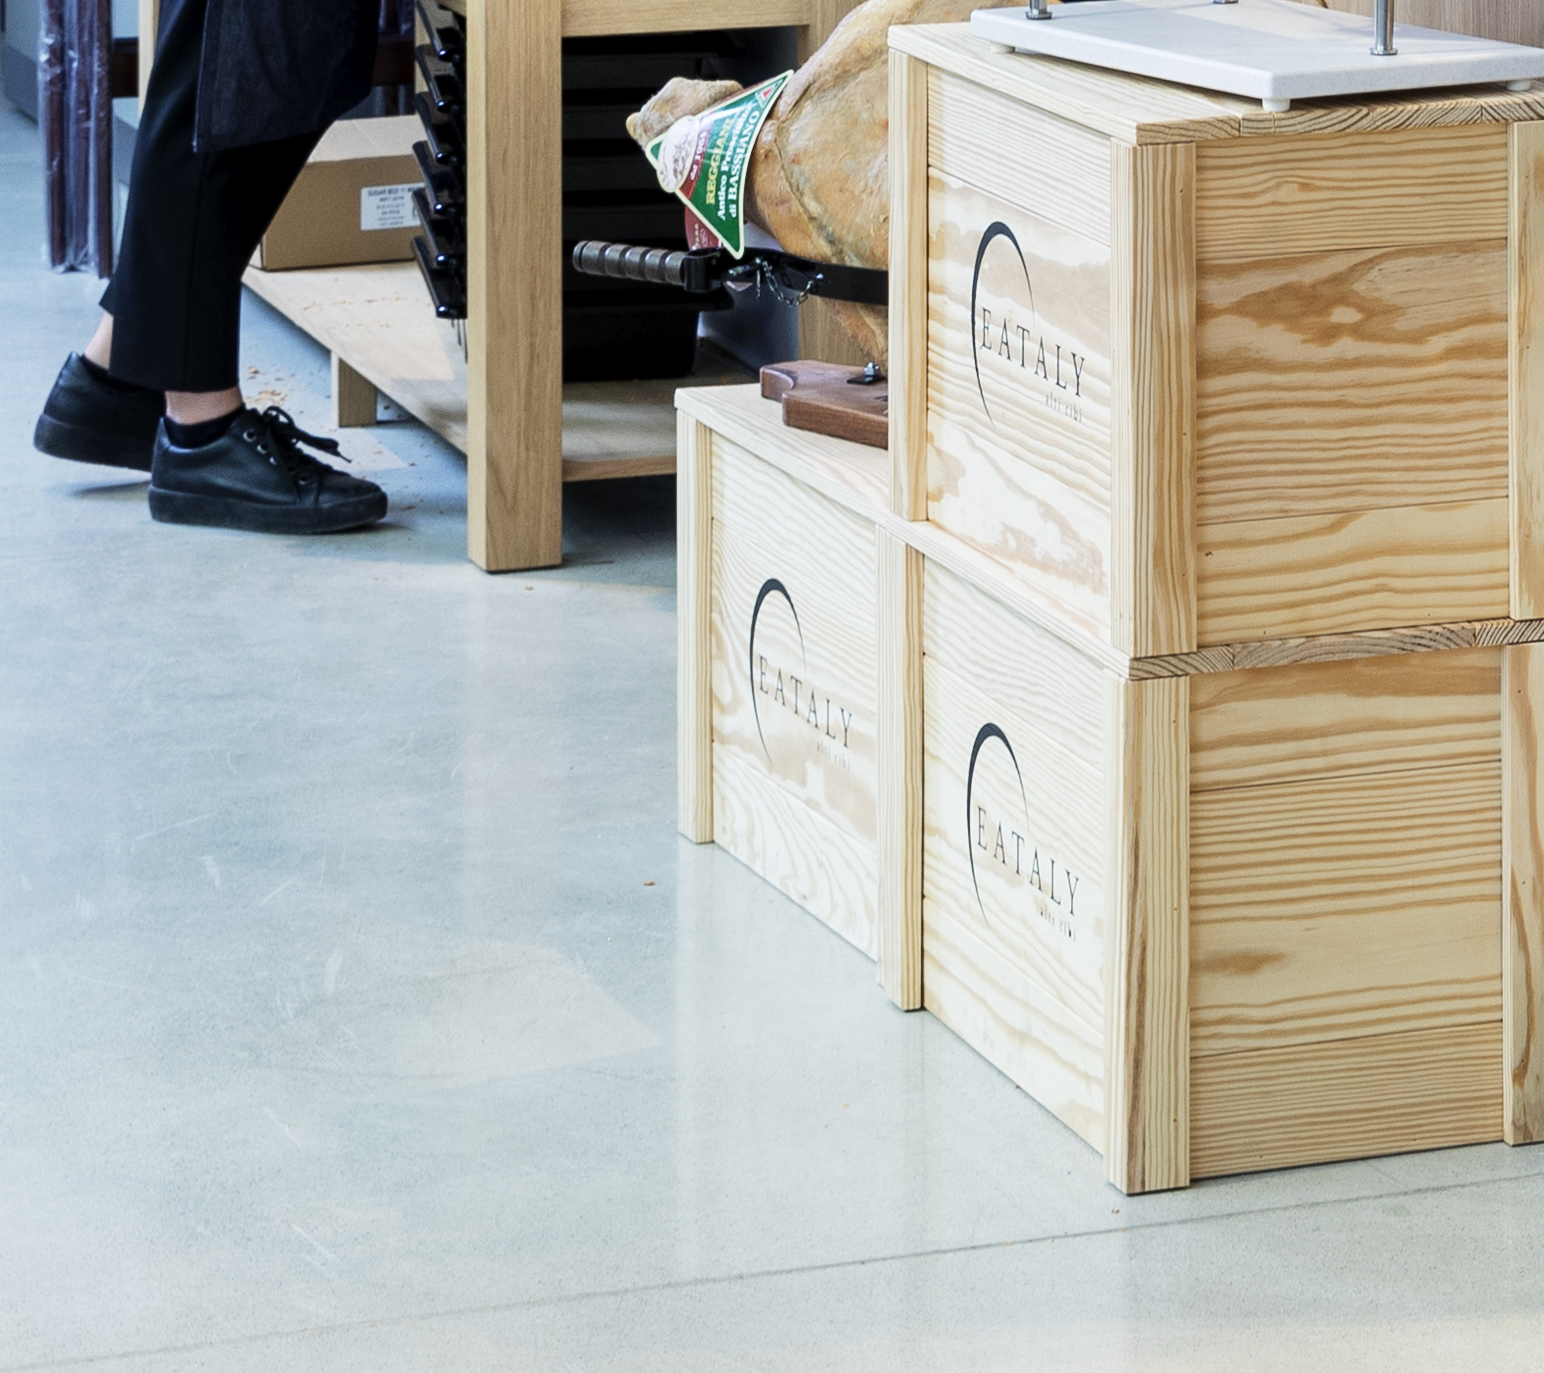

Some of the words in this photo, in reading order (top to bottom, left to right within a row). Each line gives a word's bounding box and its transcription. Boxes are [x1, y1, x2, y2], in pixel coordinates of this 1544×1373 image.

[690, 166, 698, 181] dal
[706, 117, 733, 205] REGGIANI
[721, 107, 752, 172] Prosciutto
[728, 110, 760, 200] BASSIANO
[717, 174, 728, 221] Antico
[729, 203, 737, 218] di
[981, 307, 1085, 398] EATALY
[759, 654, 854, 749] EATALY
[976, 804, 1080, 916] EATALY
